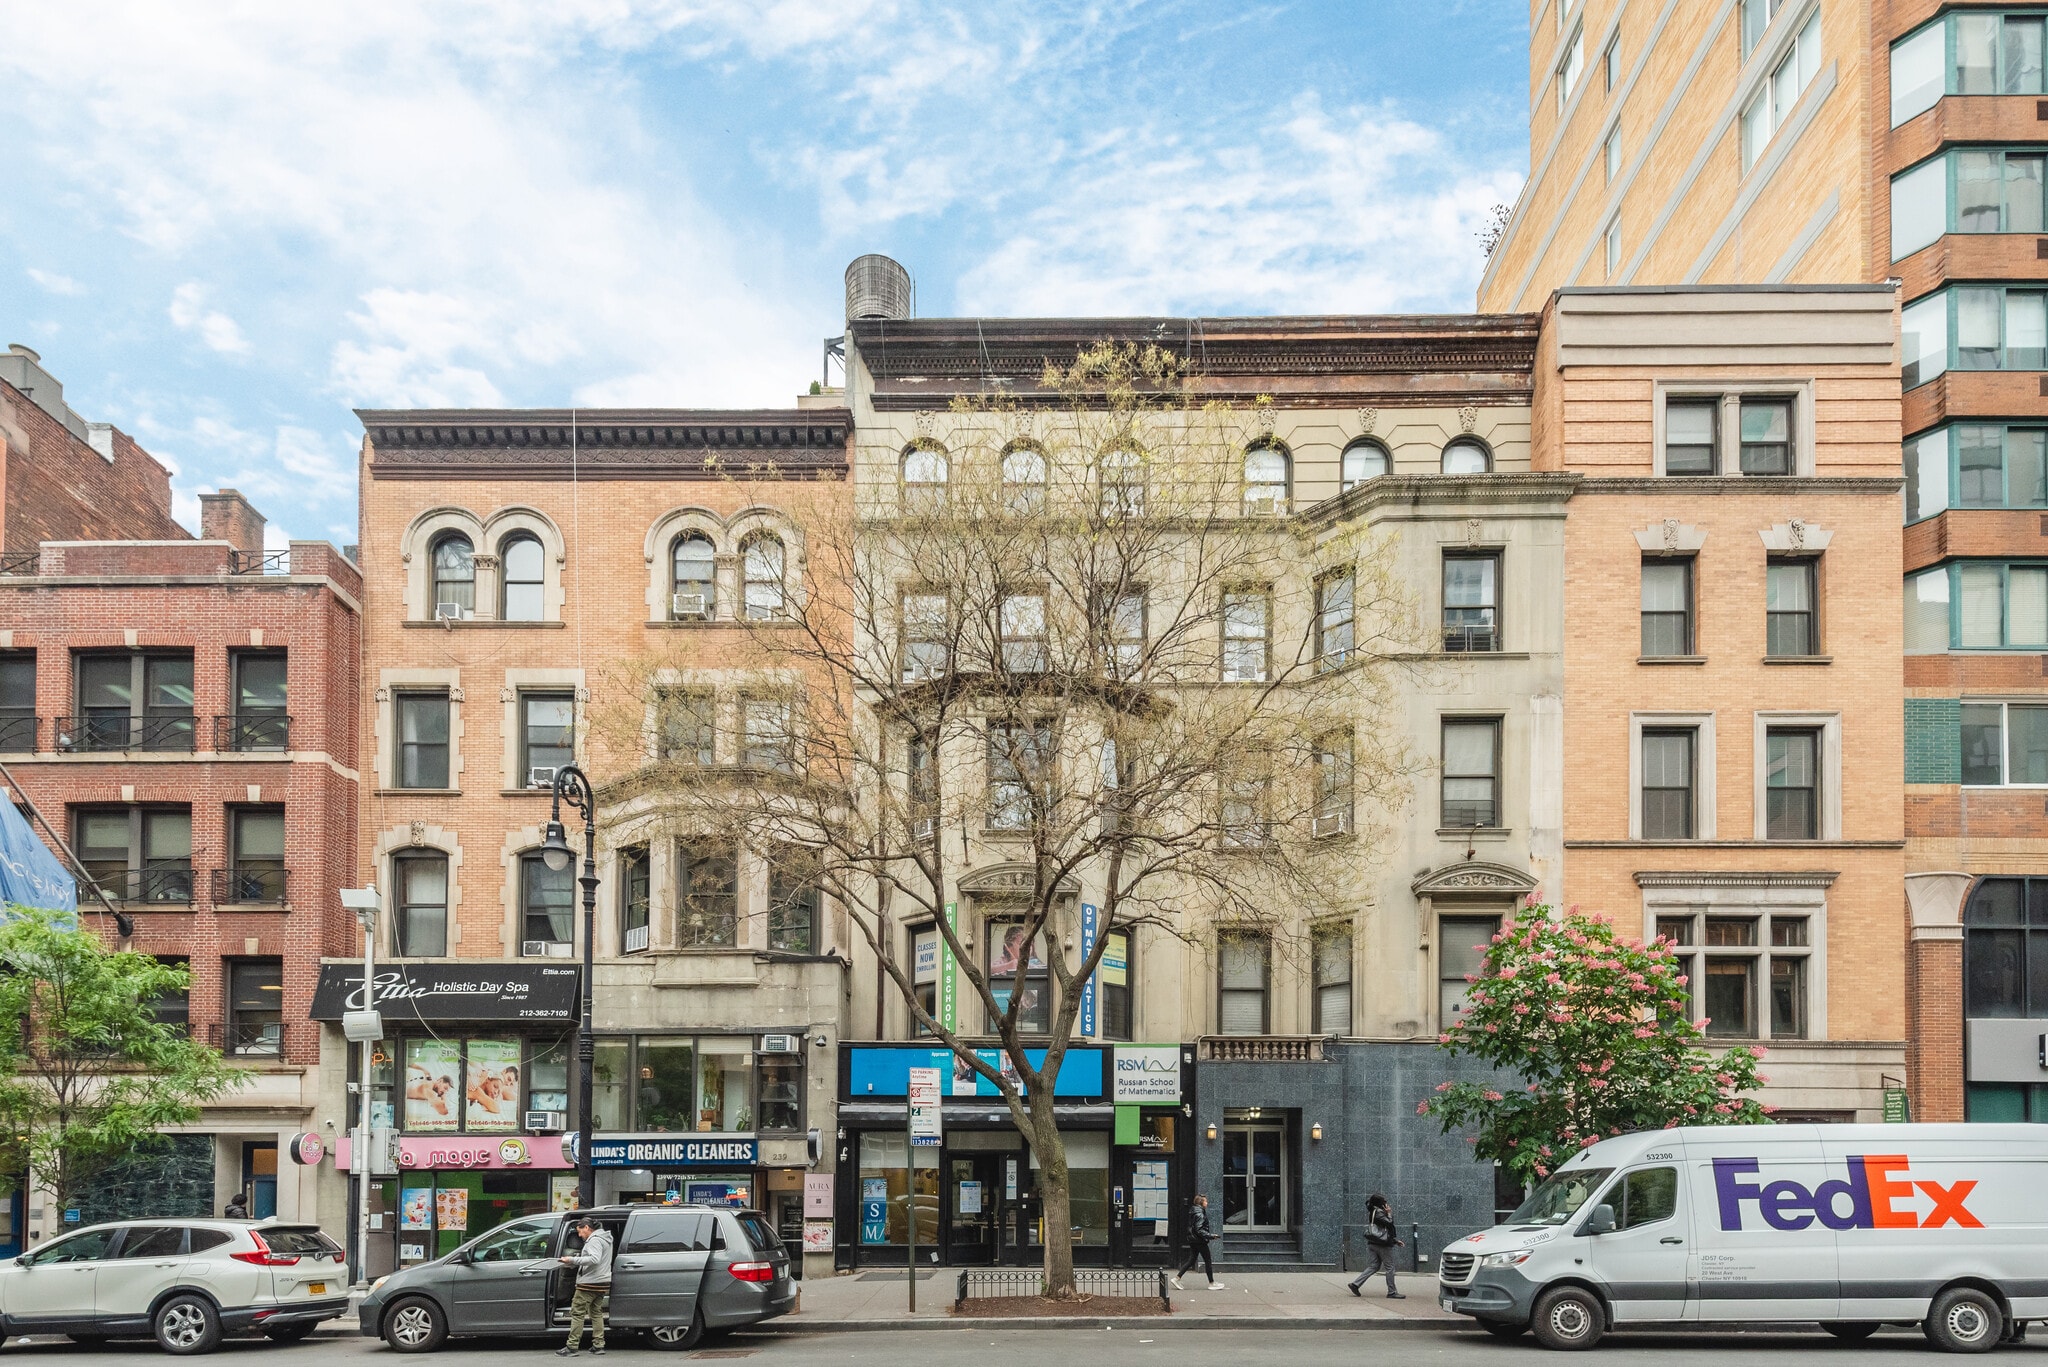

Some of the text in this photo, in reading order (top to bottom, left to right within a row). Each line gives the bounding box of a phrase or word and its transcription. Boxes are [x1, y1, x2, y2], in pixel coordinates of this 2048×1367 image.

[917, 942, 936, 952] CLASSES
[920, 952, 934, 963] NOW
[916, 963, 936, 973] ENROLLIN
[1085, 907, 1093, 1032] OF MATMATICS
[433, 982, 530, 994] Holistic Day Spa
[1117, 1059, 1145, 1071] RSM
[1118, 1078, 1176, 1086] Russian School
[1118, 1087, 1176, 1095] of Mathematics
[913, 1108, 919, 1116] 2
[591, 1146, 626, 1158] LINDA'S
[627, 1143, 684, 1160] ORGANIC
[687, 1143, 753, 1160] CLEANERS
[426, 1149, 490, 1167] magic
[1712, 1154, 1986, 1232] FedEx
[870, 1203, 880, 1218] S
[1523, 1232, 1550, 1246] 532300
[414, 1247, 422, 1256] A
